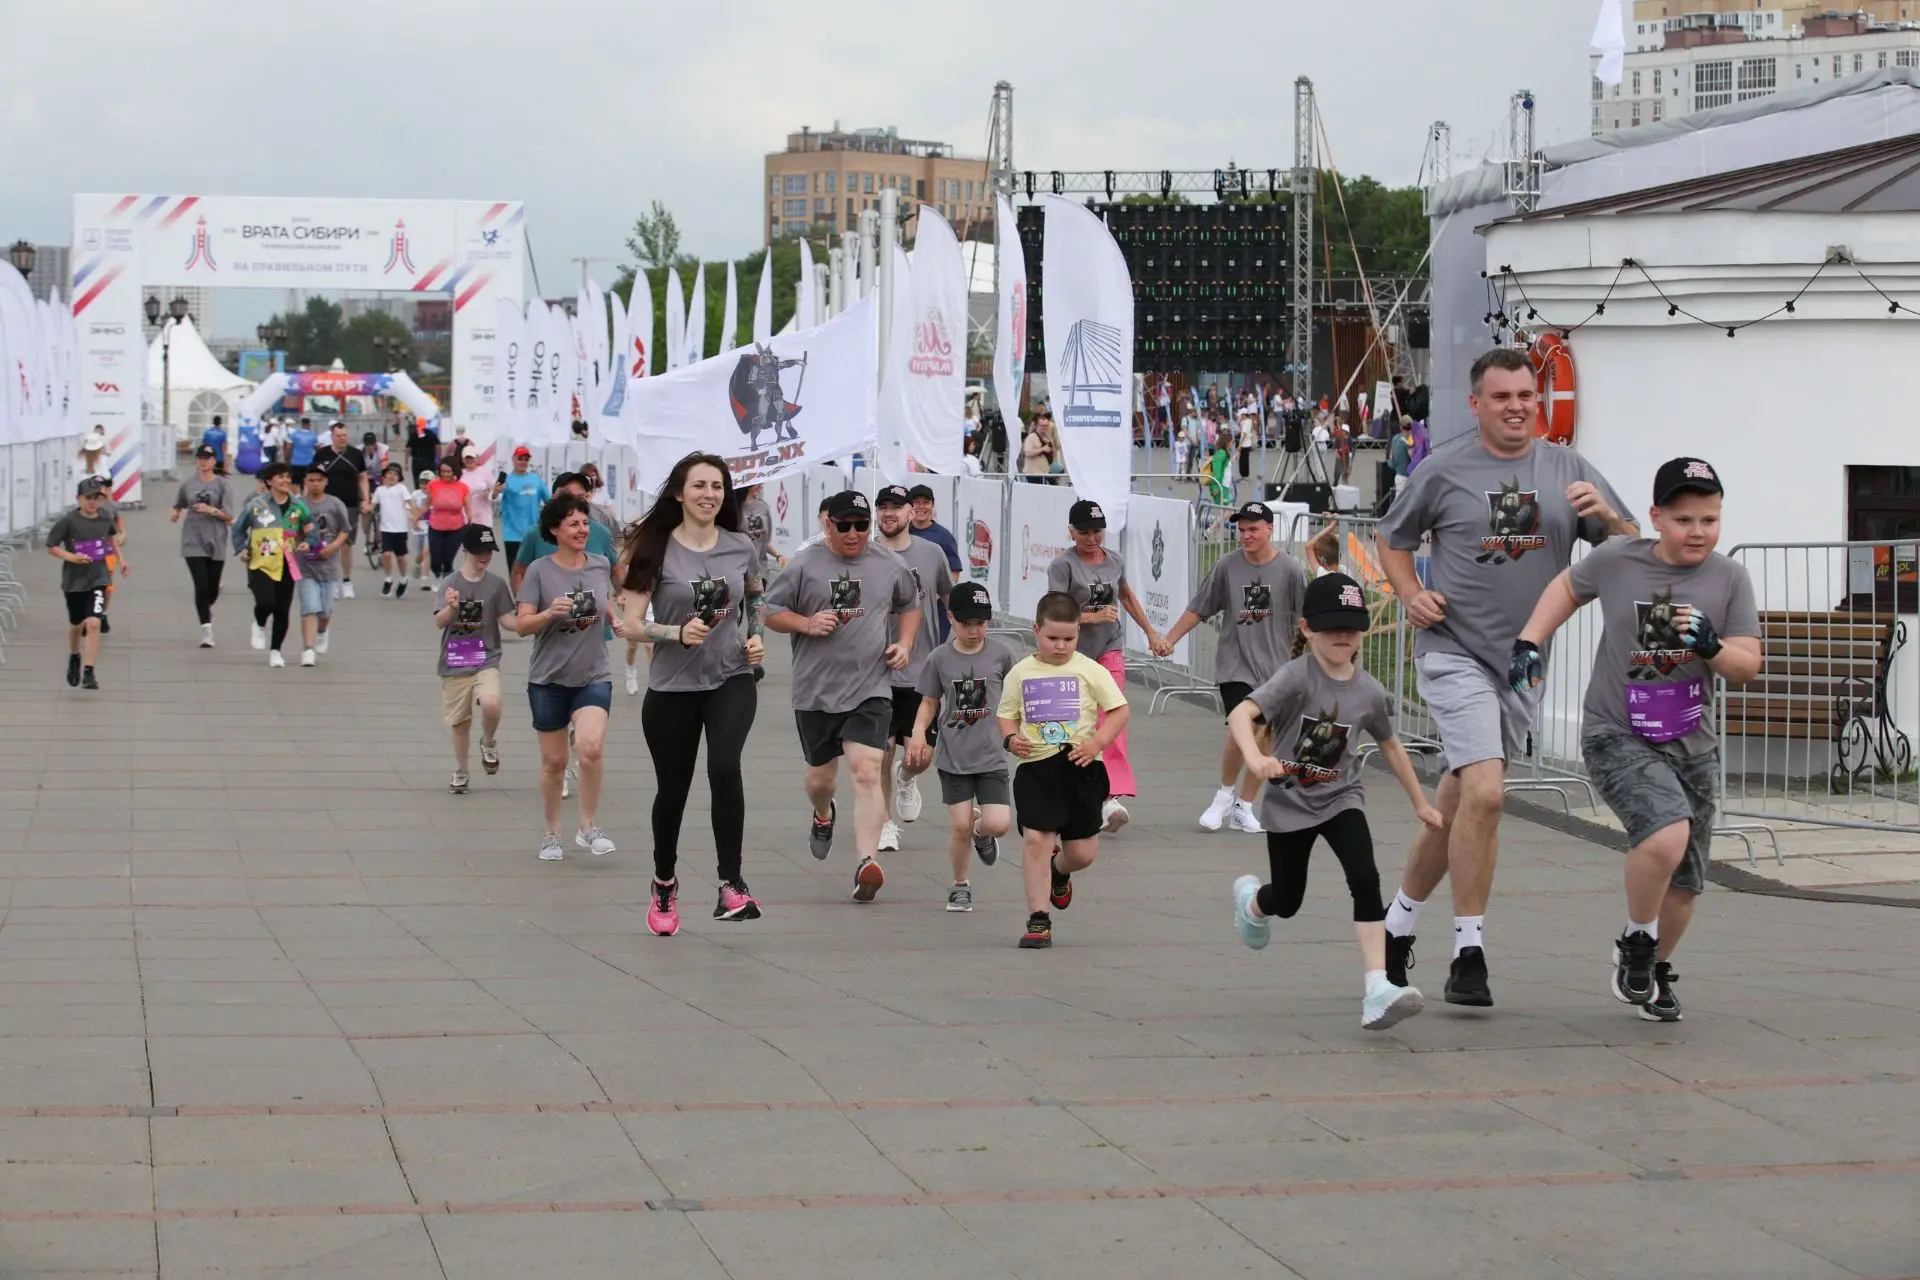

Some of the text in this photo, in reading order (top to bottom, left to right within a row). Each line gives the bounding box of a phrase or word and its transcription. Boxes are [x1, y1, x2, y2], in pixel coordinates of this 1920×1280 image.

[242, 225, 290, 239] ВРАТА
[293, 226, 360, 240] СИБИРИ
[233, 261, 368, 273] НА ПРАВИЛЬНОМ ПУТИ
[311, 380, 367, 392] СТАРТ
[1508, 534, 1548, 550] ТОР
[1060, 680, 1077, 692] 313
[1689, 683, 1701, 699] 14
